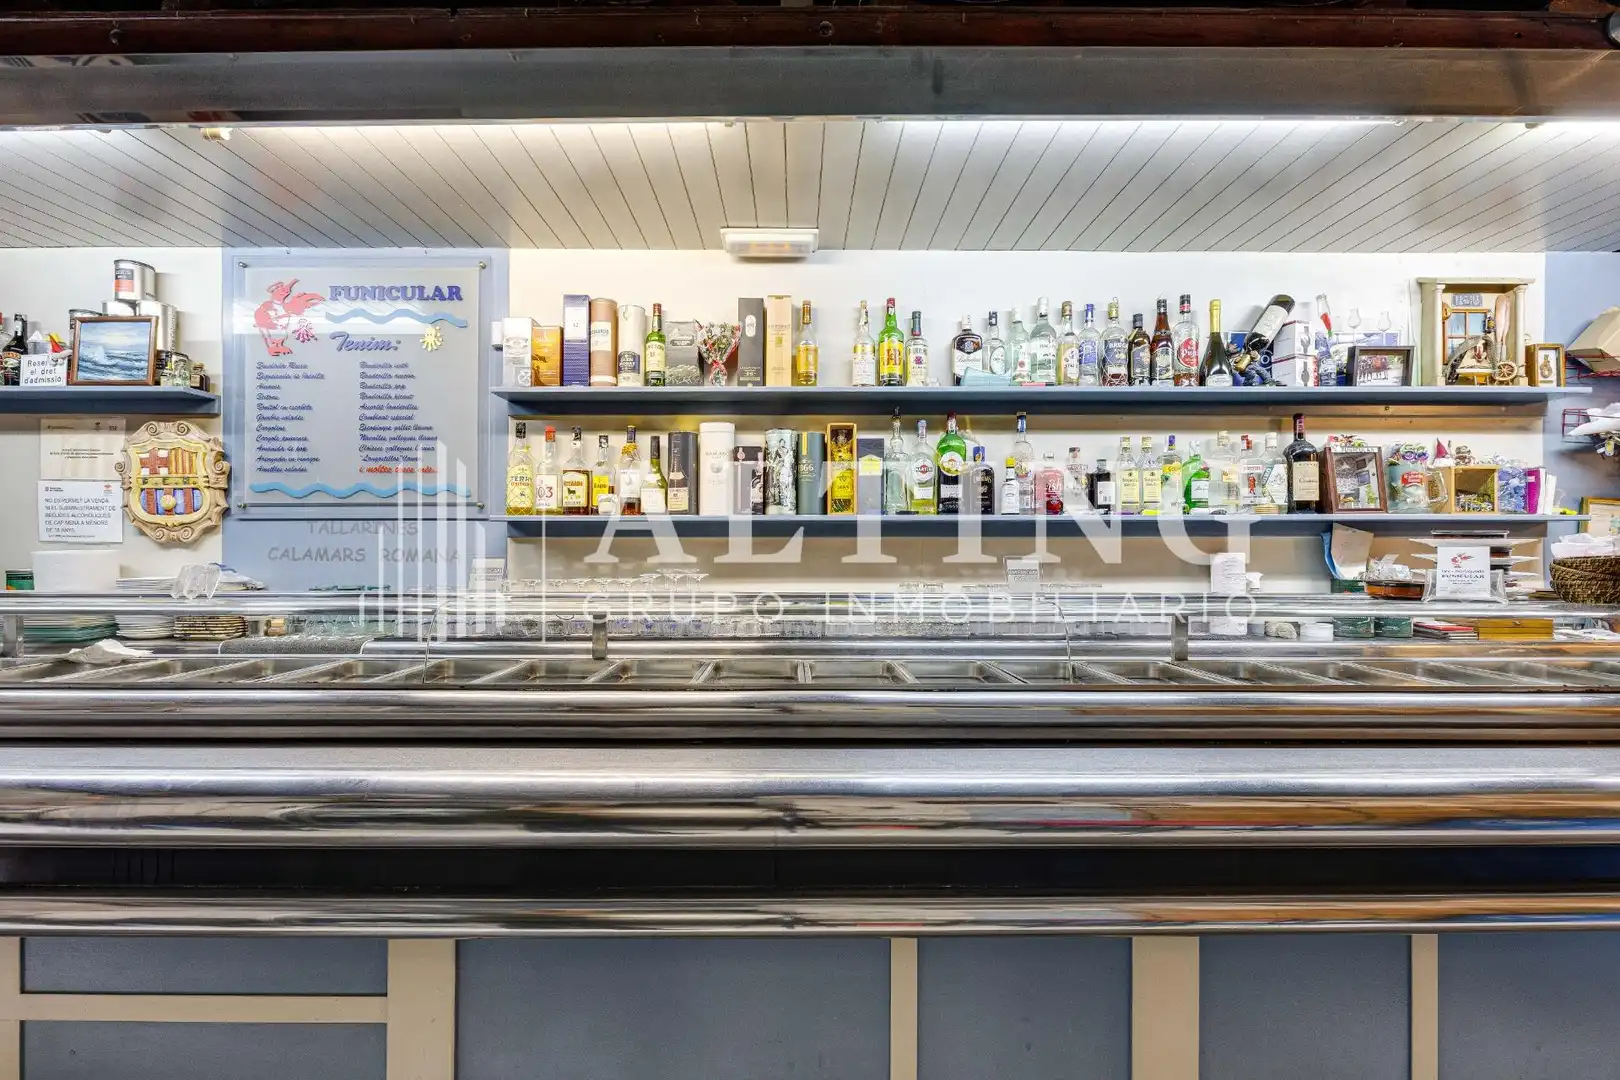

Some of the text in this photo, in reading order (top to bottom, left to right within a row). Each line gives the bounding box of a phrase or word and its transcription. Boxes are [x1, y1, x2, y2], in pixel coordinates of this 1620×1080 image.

[329, 285, 463, 301] FUNICULAR
[329, 331, 402, 351] Tenim:
[30, 367, 57, 375] el dret
[307, 520, 419, 536] TALLARINES
[268, 546, 366, 562] CALAMARS
